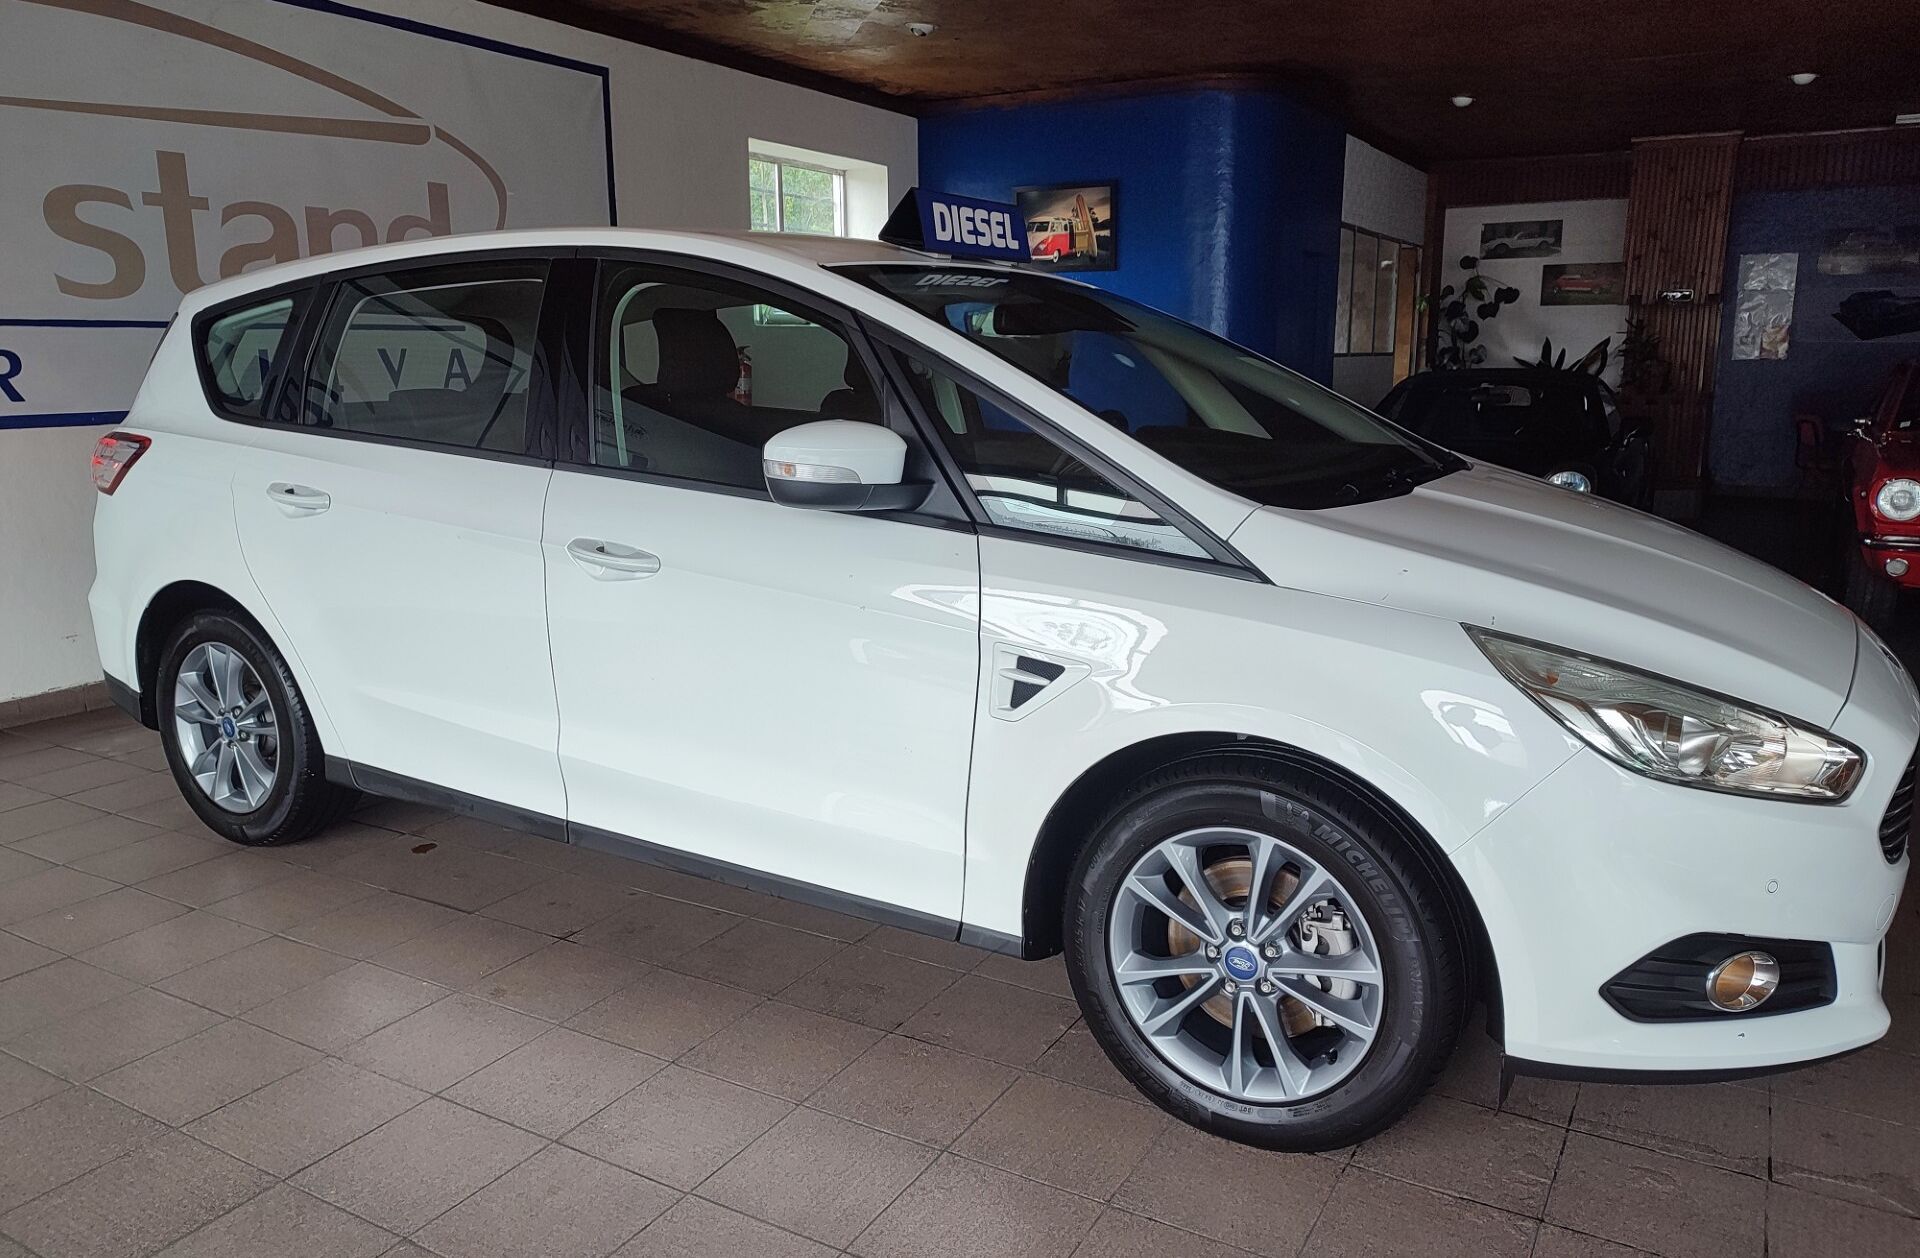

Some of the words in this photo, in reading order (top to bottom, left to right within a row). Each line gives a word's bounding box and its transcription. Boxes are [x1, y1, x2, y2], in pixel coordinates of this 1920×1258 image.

[42, 150, 453, 299] stand
[932, 201, 1020, 250] DIESEL
[1314, 824, 1417, 938] MICHELIN
